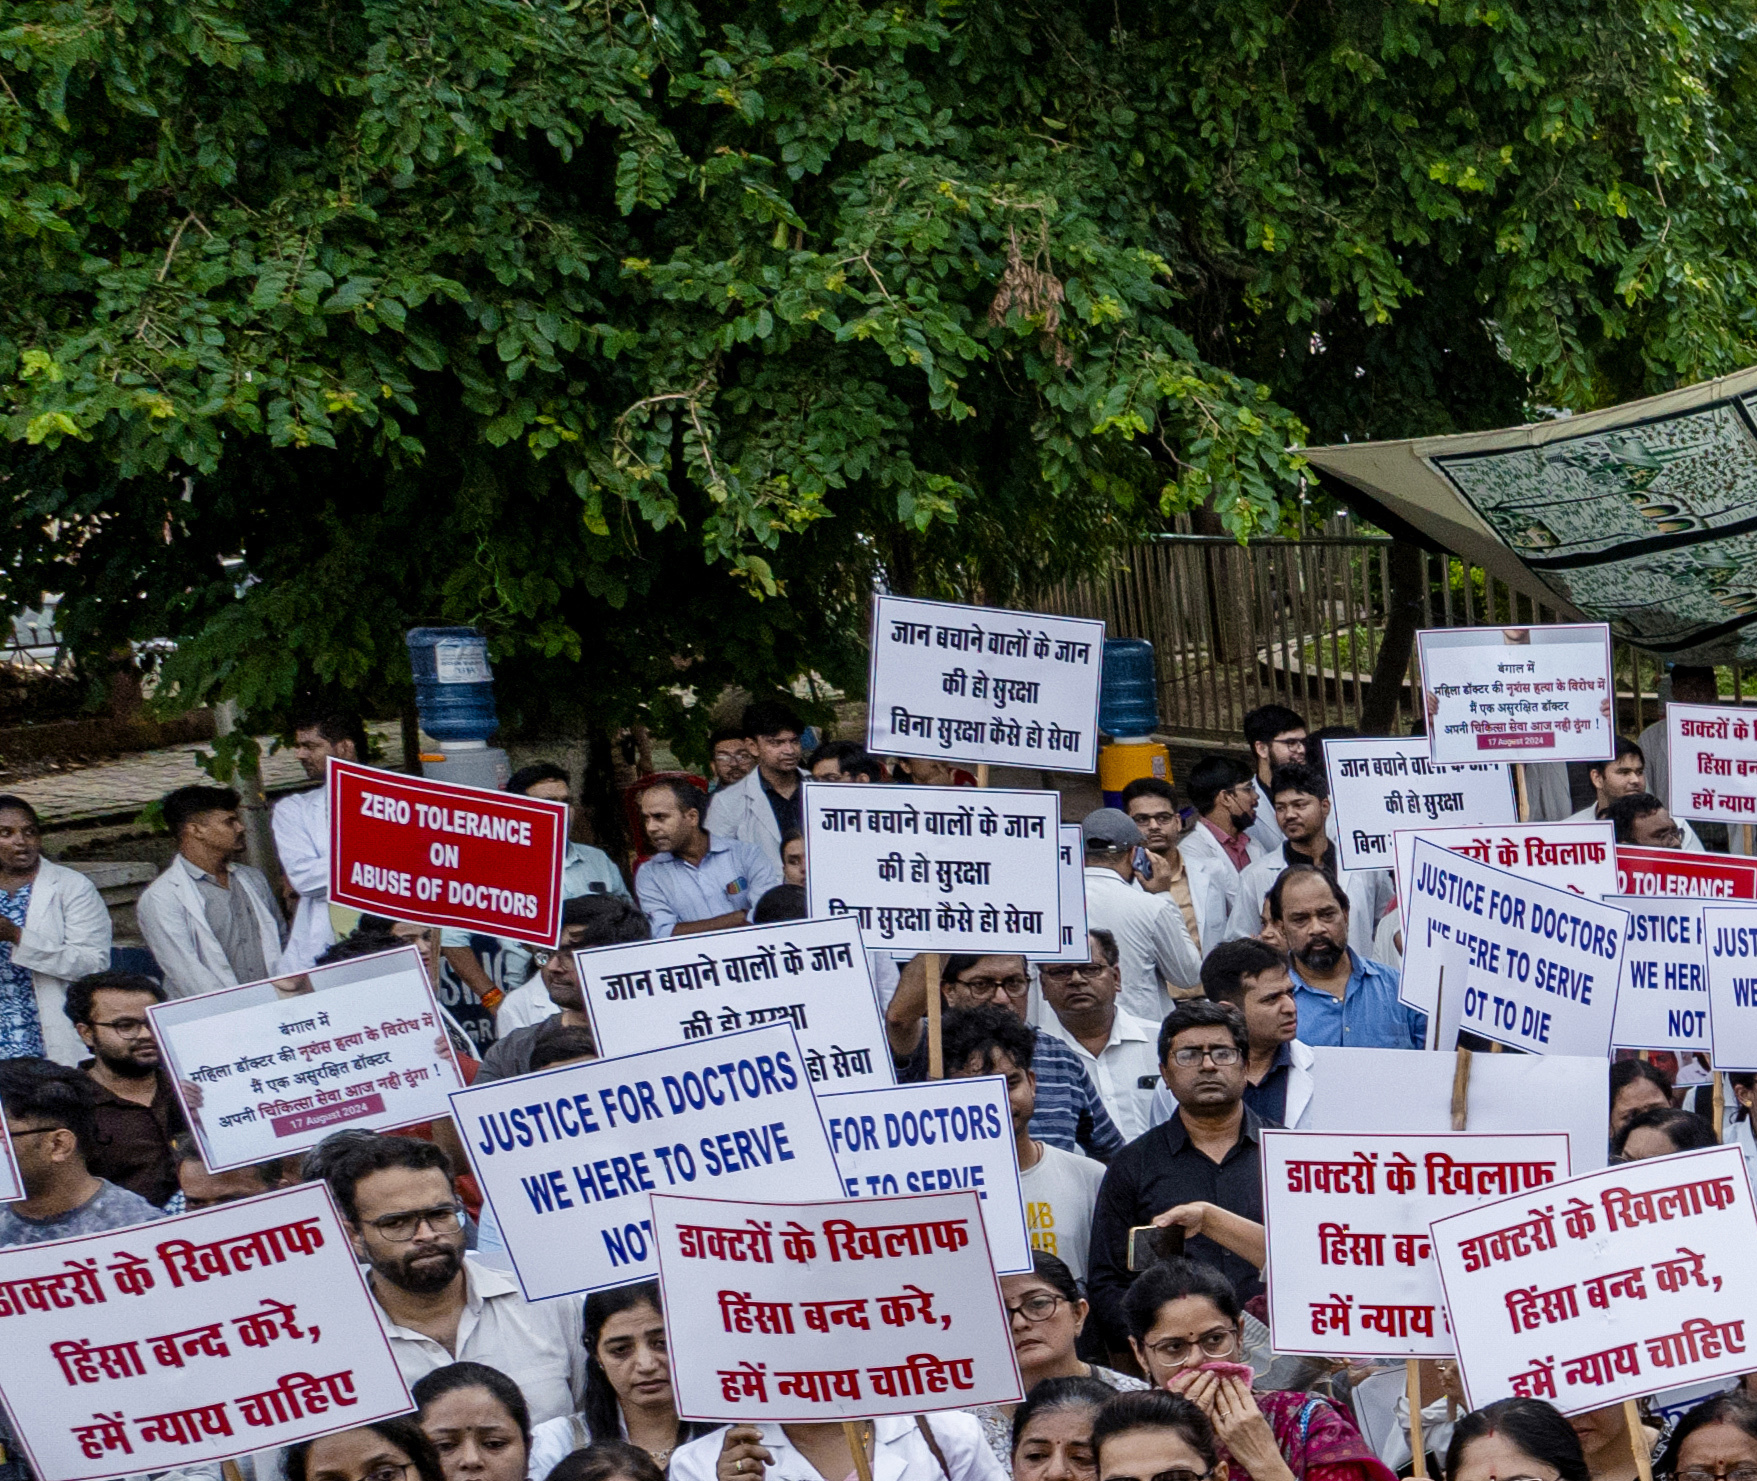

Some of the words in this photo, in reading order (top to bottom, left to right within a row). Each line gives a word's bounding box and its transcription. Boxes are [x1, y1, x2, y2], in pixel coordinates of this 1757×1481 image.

[891, 621, 932, 646] जान
[936, 623, 985, 653] बचाने
[988, 629, 1031, 657] वालों
[1034, 631, 1051, 659] के
[1055, 640, 1091, 664] जान
[942, 668, 968, 696] की
[972, 670, 990, 698] हो
[993, 678, 1040, 709] सुरक्षा
[891, 706, 934, 738] बिना
[938, 718, 986, 749] सुरक्षा
[990, 717, 1022, 746] कैसे
[1026, 720, 1044, 748] हो
[1048, 722, 1081, 752] सेवा
[361, 792, 410, 824] ZERO
[415, 803, 531, 846] TOLERANCE
[430, 843, 458, 868] ON
[351, 862, 411, 897] ABUSE
[417, 877, 442, 901] OF
[449, 881, 537, 918] DOCTORS
